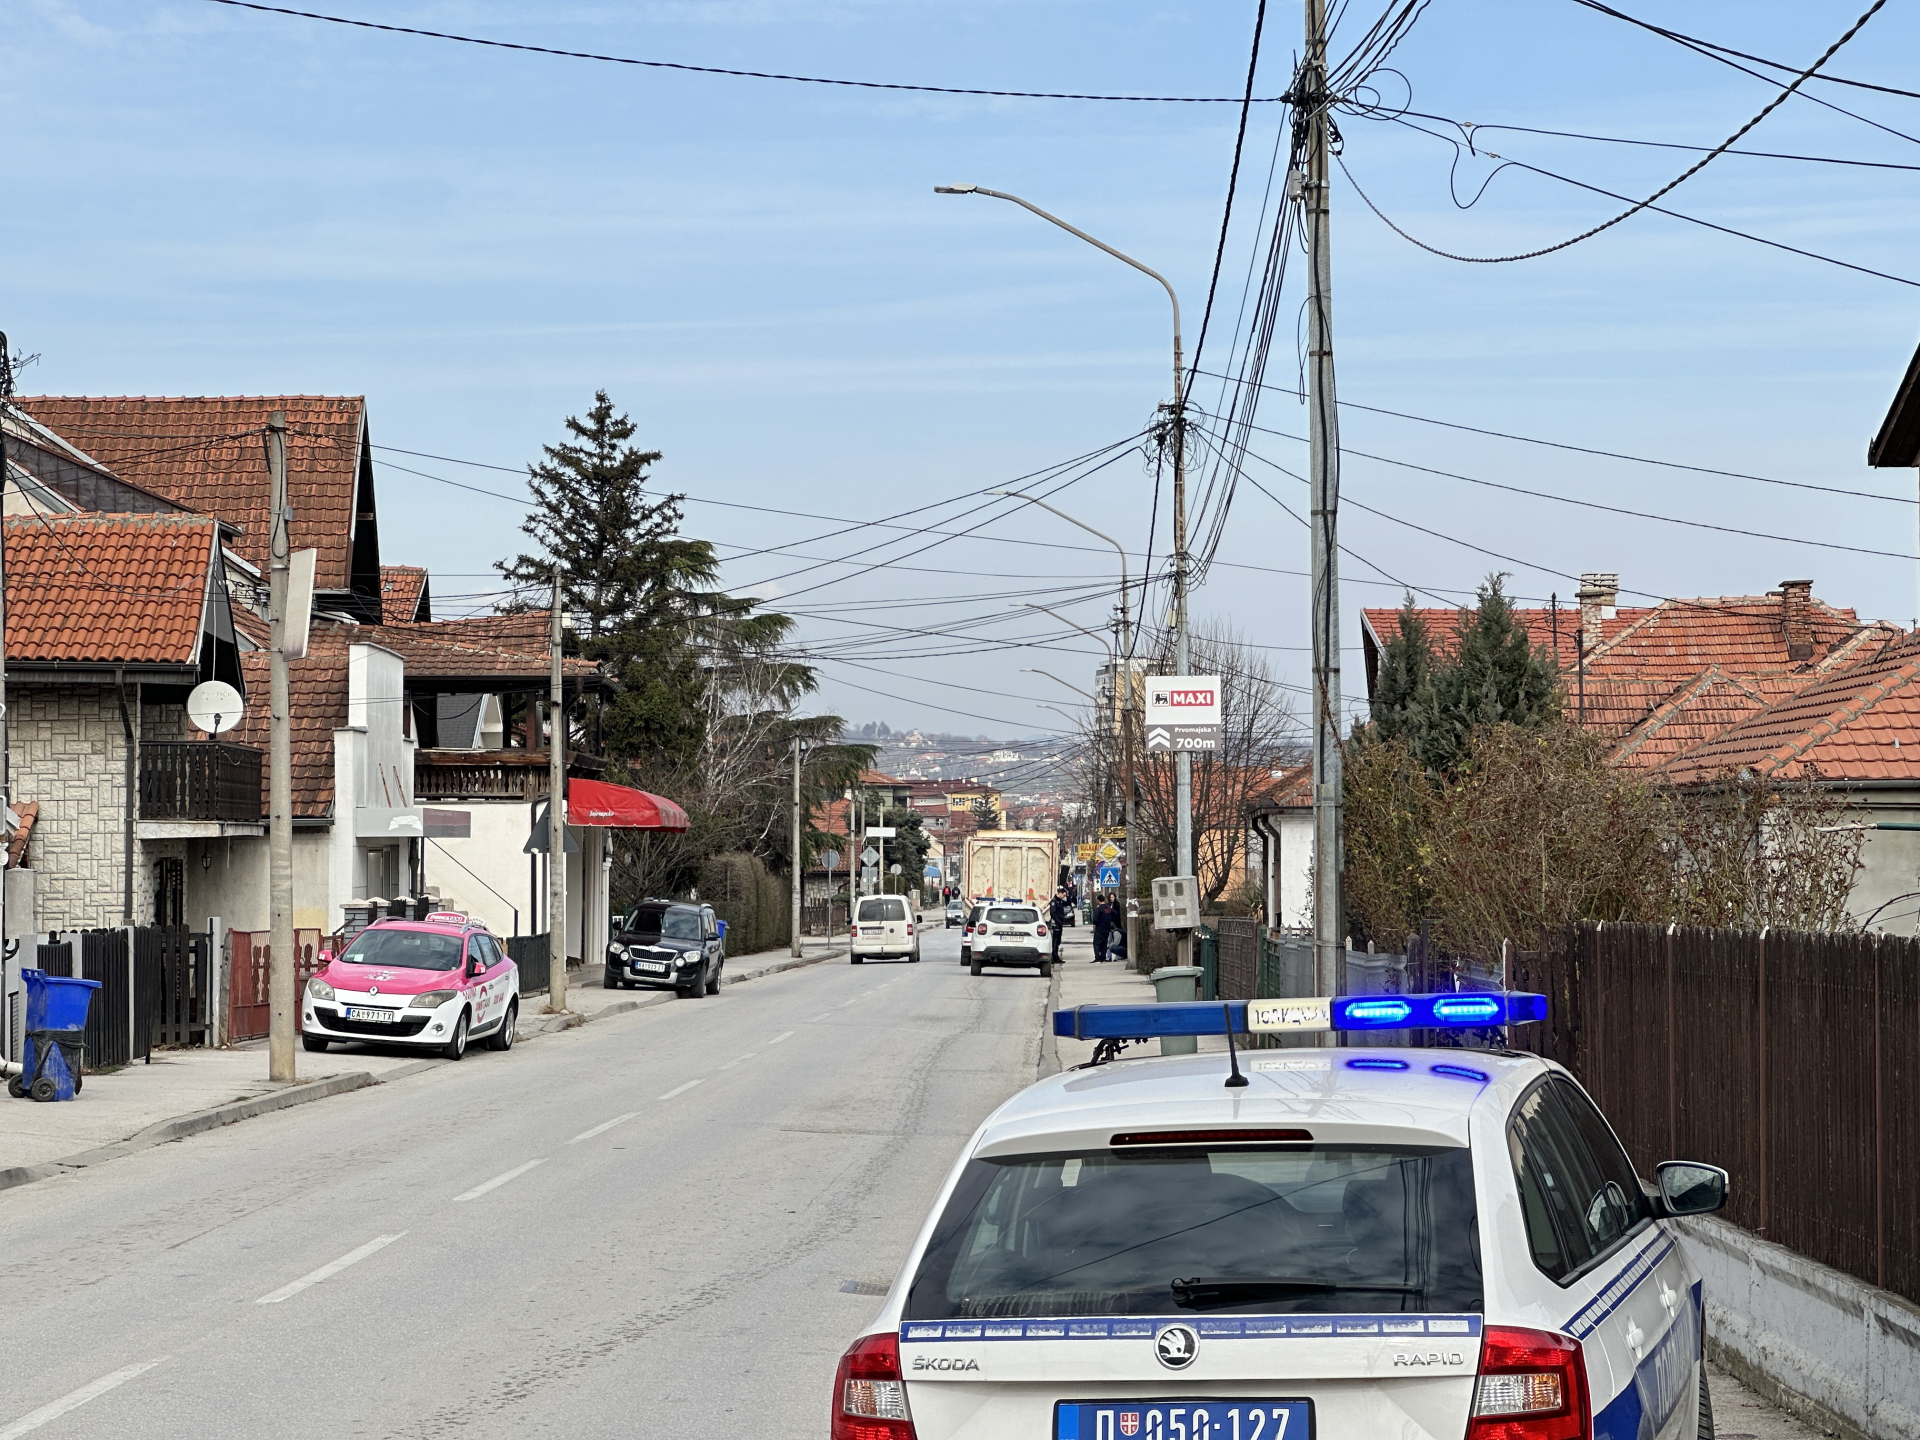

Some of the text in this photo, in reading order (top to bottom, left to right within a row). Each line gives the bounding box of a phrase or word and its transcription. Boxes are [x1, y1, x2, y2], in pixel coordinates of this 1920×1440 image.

[1173, 692, 1211, 705] MAXI
[1174, 726, 1212, 734] Prvomajska
[1176, 738, 1216, 749] 700m
[912, 1355, 980, 1371] ŠKODA
[1393, 1352, 1464, 1367] RAPID
